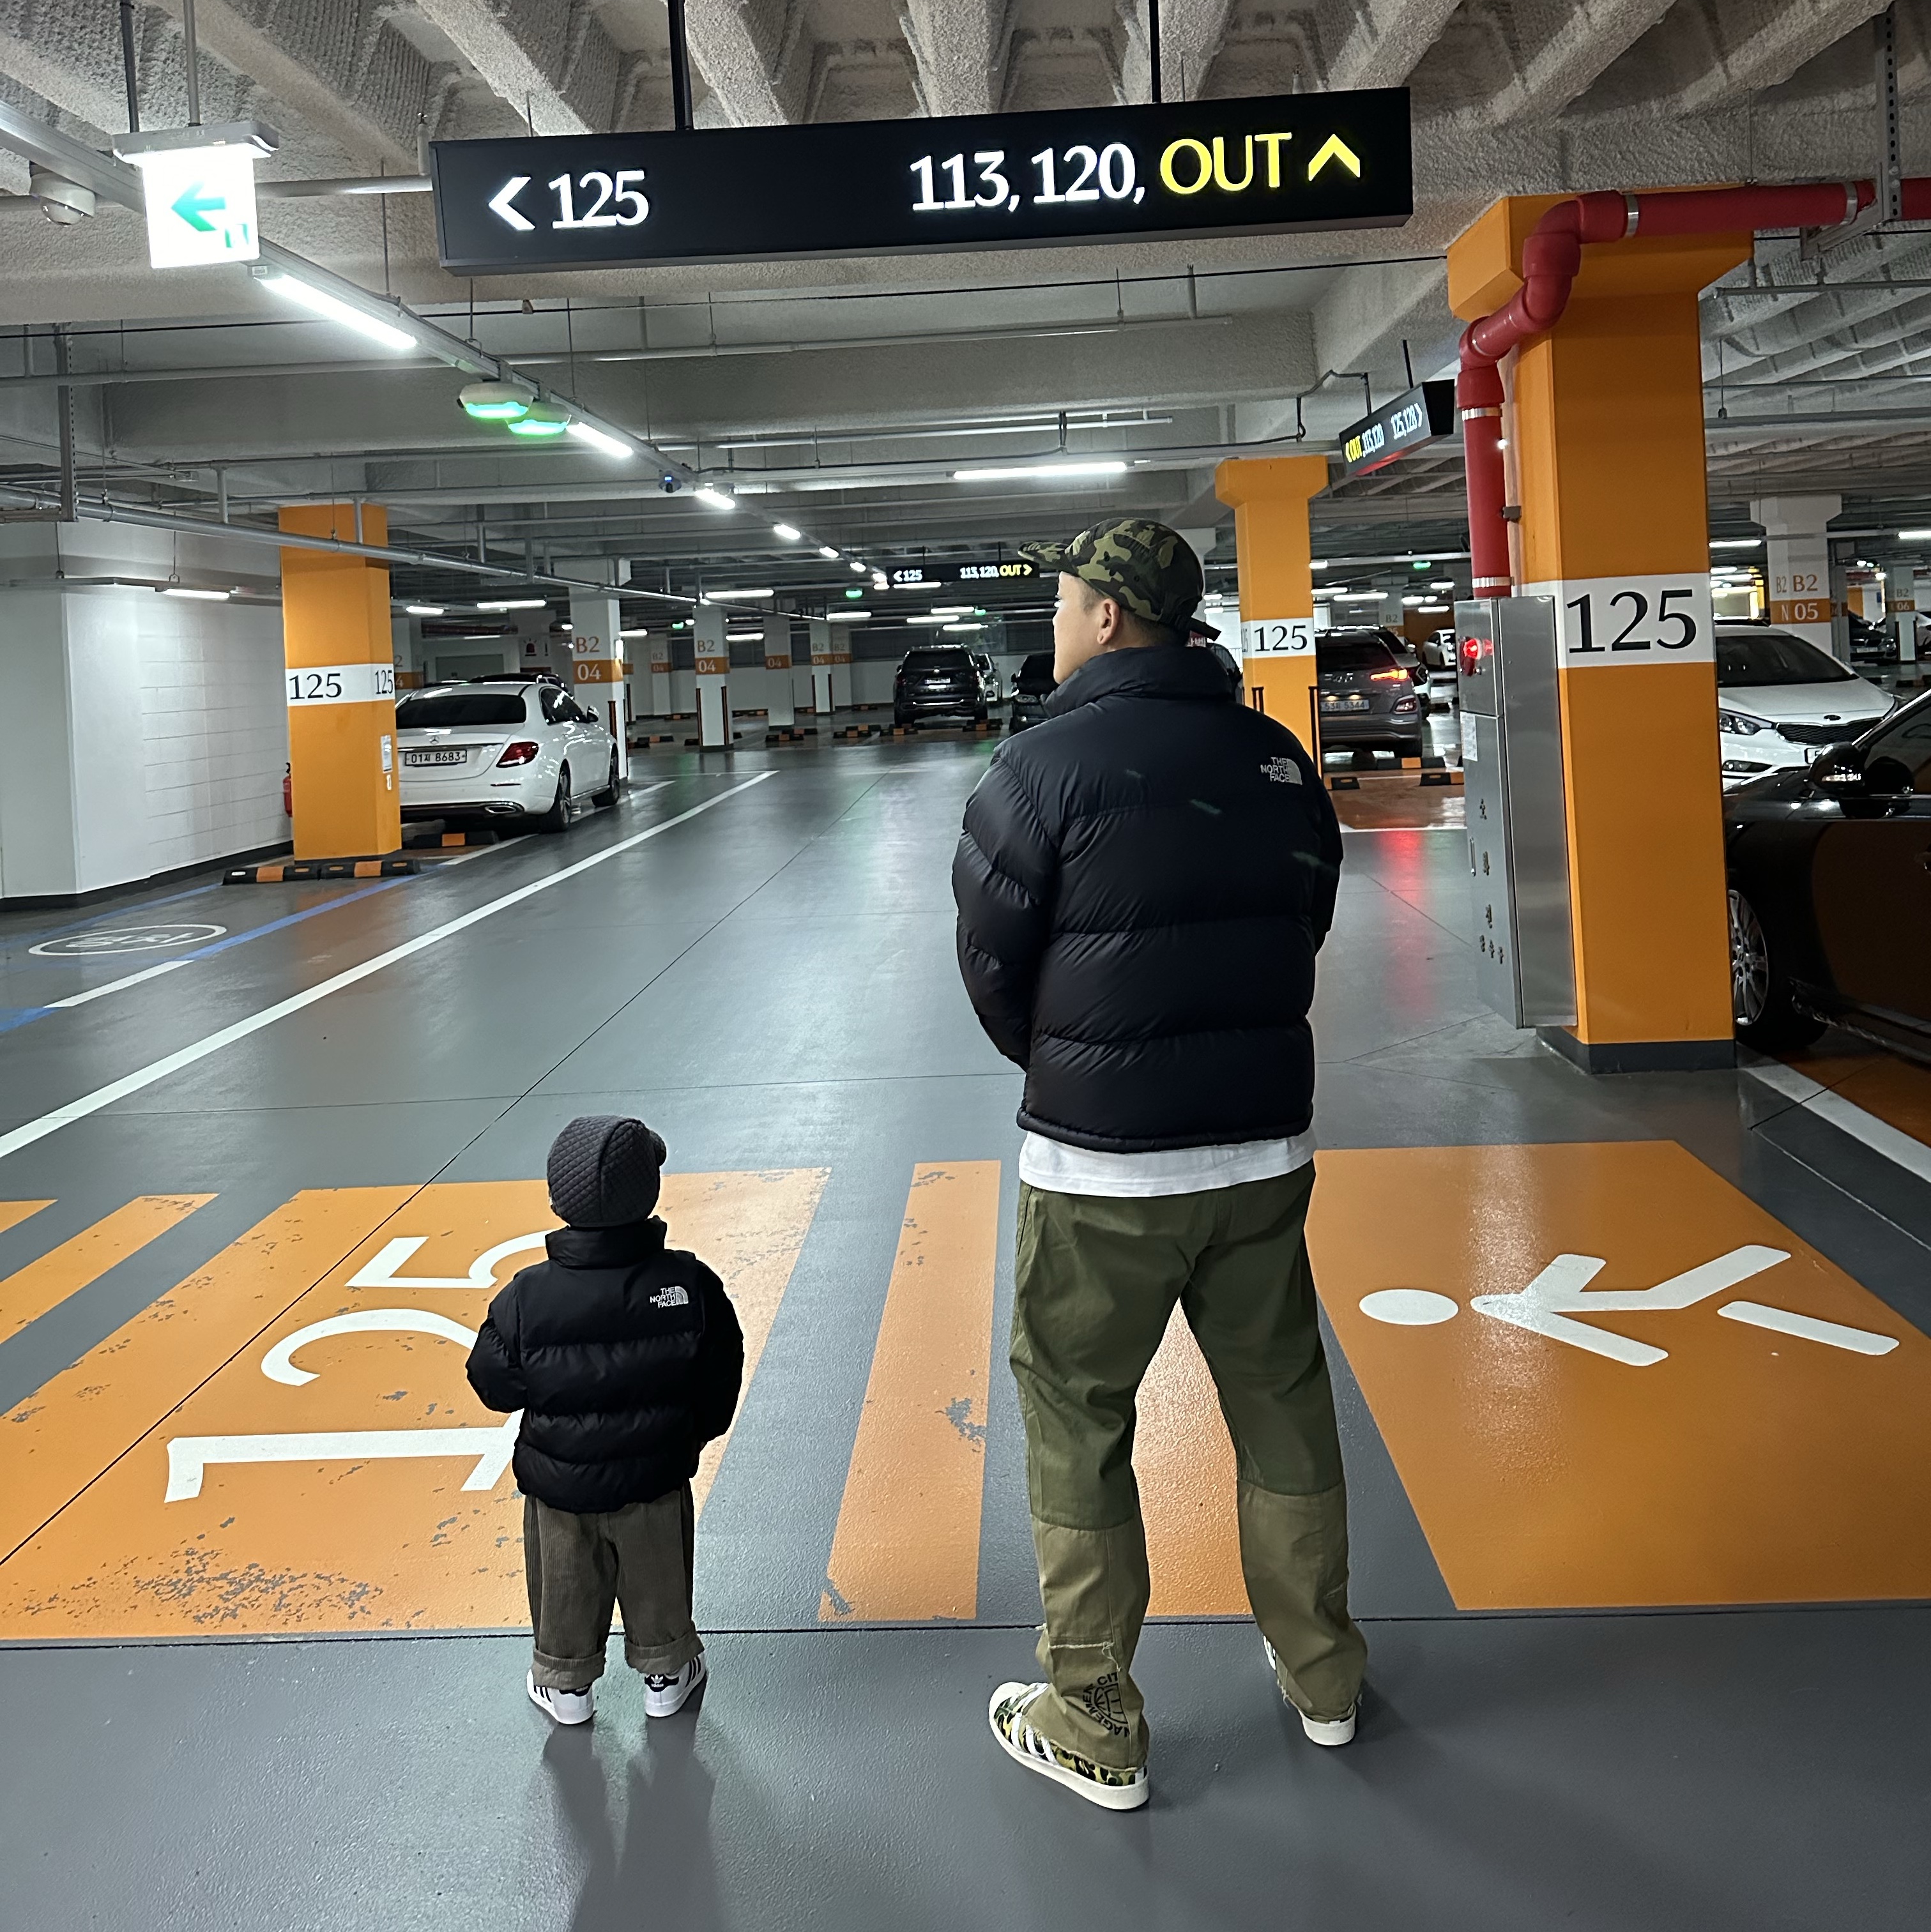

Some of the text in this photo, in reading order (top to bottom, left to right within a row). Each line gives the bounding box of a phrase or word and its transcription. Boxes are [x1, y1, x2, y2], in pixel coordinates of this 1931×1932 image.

[1159, 132, 1292, 195] OUT
[548, 170, 649, 229] 125
[903, 569, 922, 581] 125
[999, 565, 1021, 576] OUT
[1776, 575, 1787, 593] B2
[1792, 574, 1818, 592] B2
[1897, 588, 1909, 597] B2
[1781, 604, 1789, 621] N
[1794, 602, 1819, 620] 05
[1897, 602, 1910, 611] 06
[1385, 614, 1398, 623] B2
[1567, 589, 1697, 653] 125
[1254, 625, 1308, 651] 125
[576, 636, 600, 653] B2
[697, 639, 715, 652] B2
[812, 643, 824, 651] B2
[768, 657, 782, 668] 04
[813, 655, 825, 664] 04
[577, 663, 602, 681] 04
[698, 660, 716, 673] 04
[289, 673, 342, 699] 125
[375, 669, 393, 694] 125
[435, 752, 461, 762] 8683
[1271, 756, 1287, 766] THE
[1260, 764, 1288, 773] NORTH
[1270, 773, 1290, 782] FACE
[660, 1286, 675, 1295] THE
[650, 1293, 676, 1304] NORTH
[657, 1300, 676, 1309] FACE
